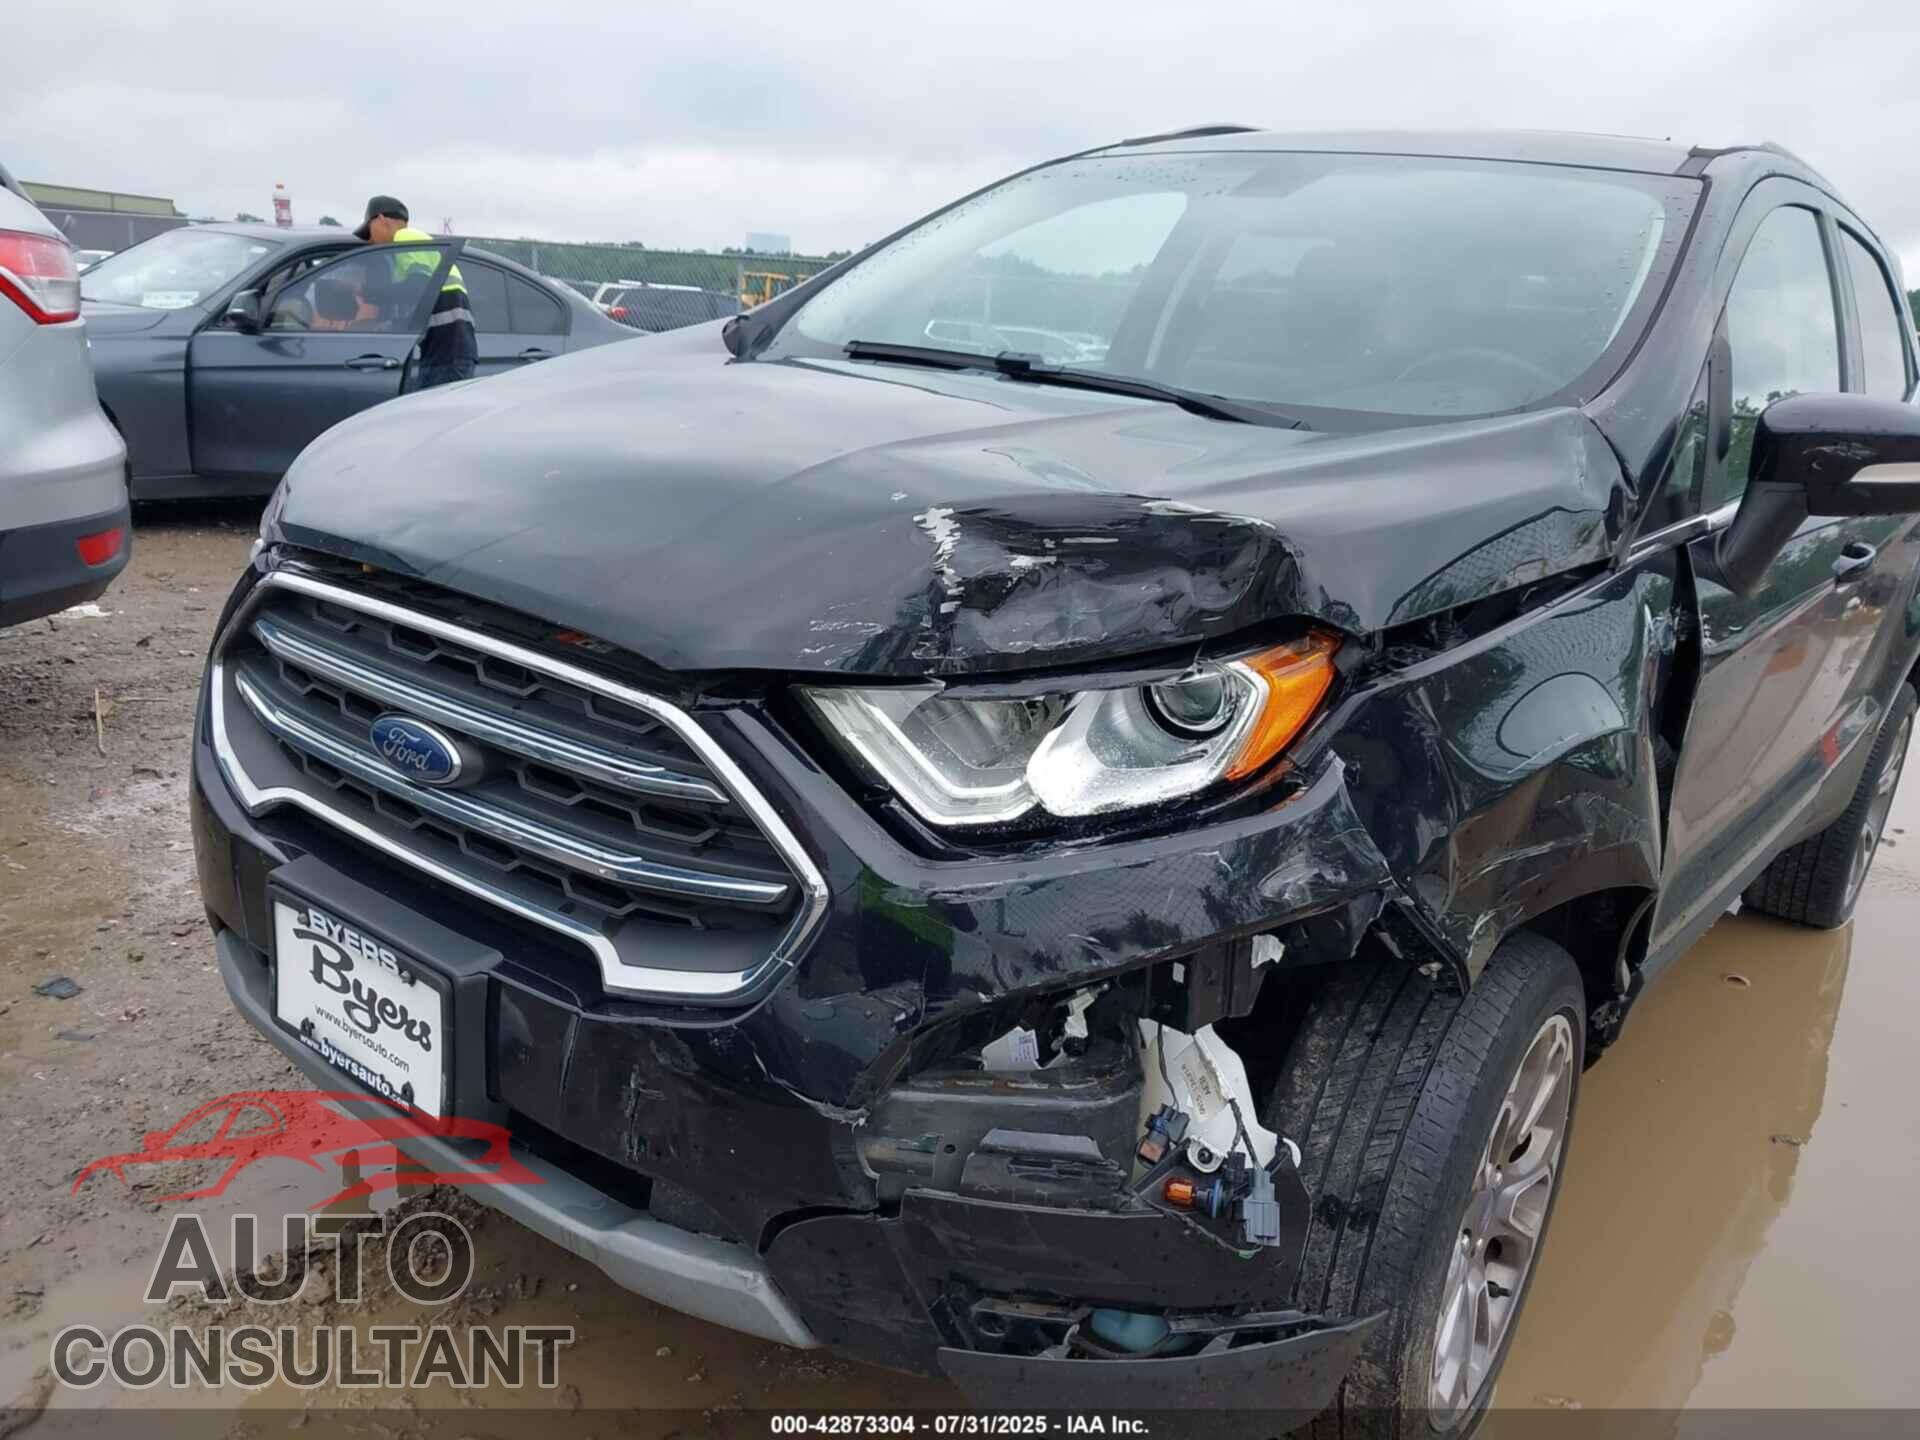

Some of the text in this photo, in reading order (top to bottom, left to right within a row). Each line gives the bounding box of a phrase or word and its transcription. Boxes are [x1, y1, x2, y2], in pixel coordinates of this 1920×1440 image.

[383, 727, 432, 770] Ford
[307, 908, 399, 977] BYERS
[315, 1003, 410, 1074] www.byersauto.com
